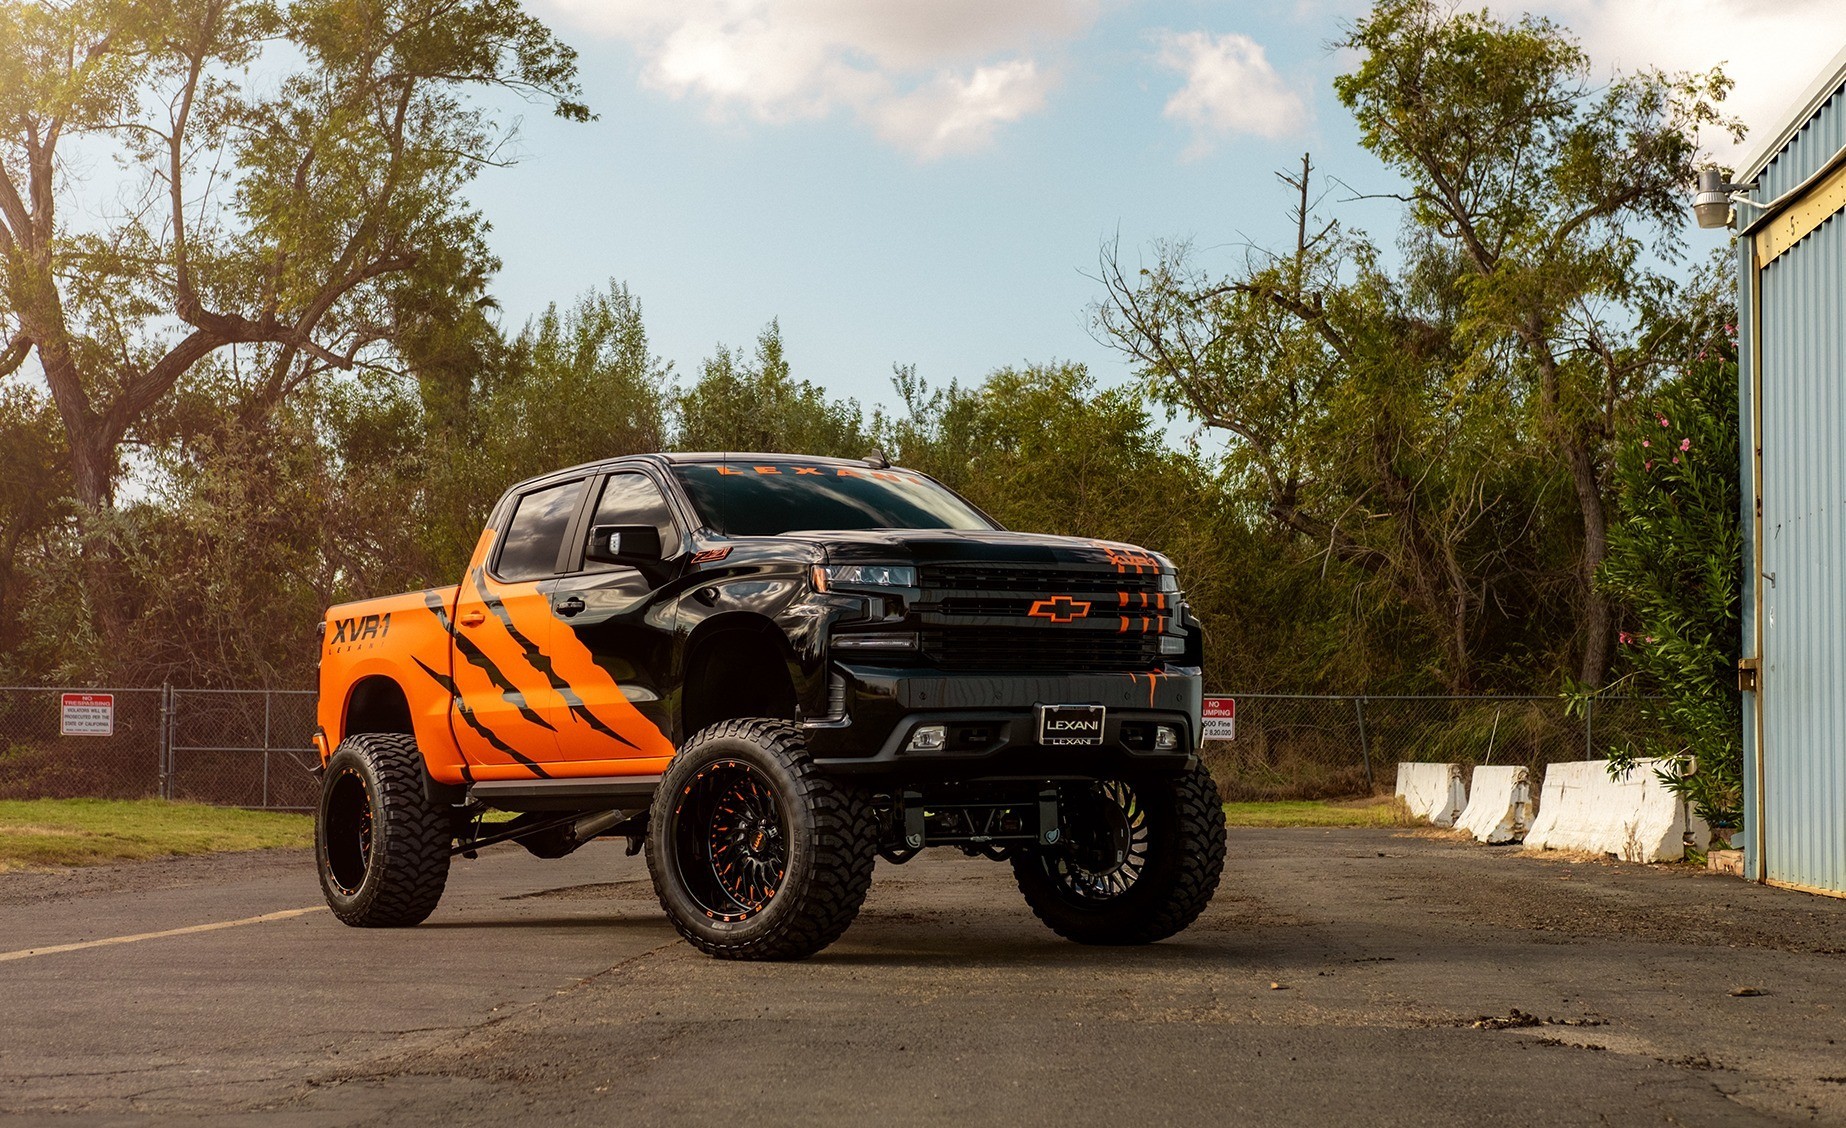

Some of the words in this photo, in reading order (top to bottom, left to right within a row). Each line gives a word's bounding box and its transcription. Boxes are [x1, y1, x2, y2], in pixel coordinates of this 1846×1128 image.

[716, 466, 923, 486] LEXANI
[1202, 709, 1231, 717] UMPING
[1047, 720, 1099, 731] LEXANI
